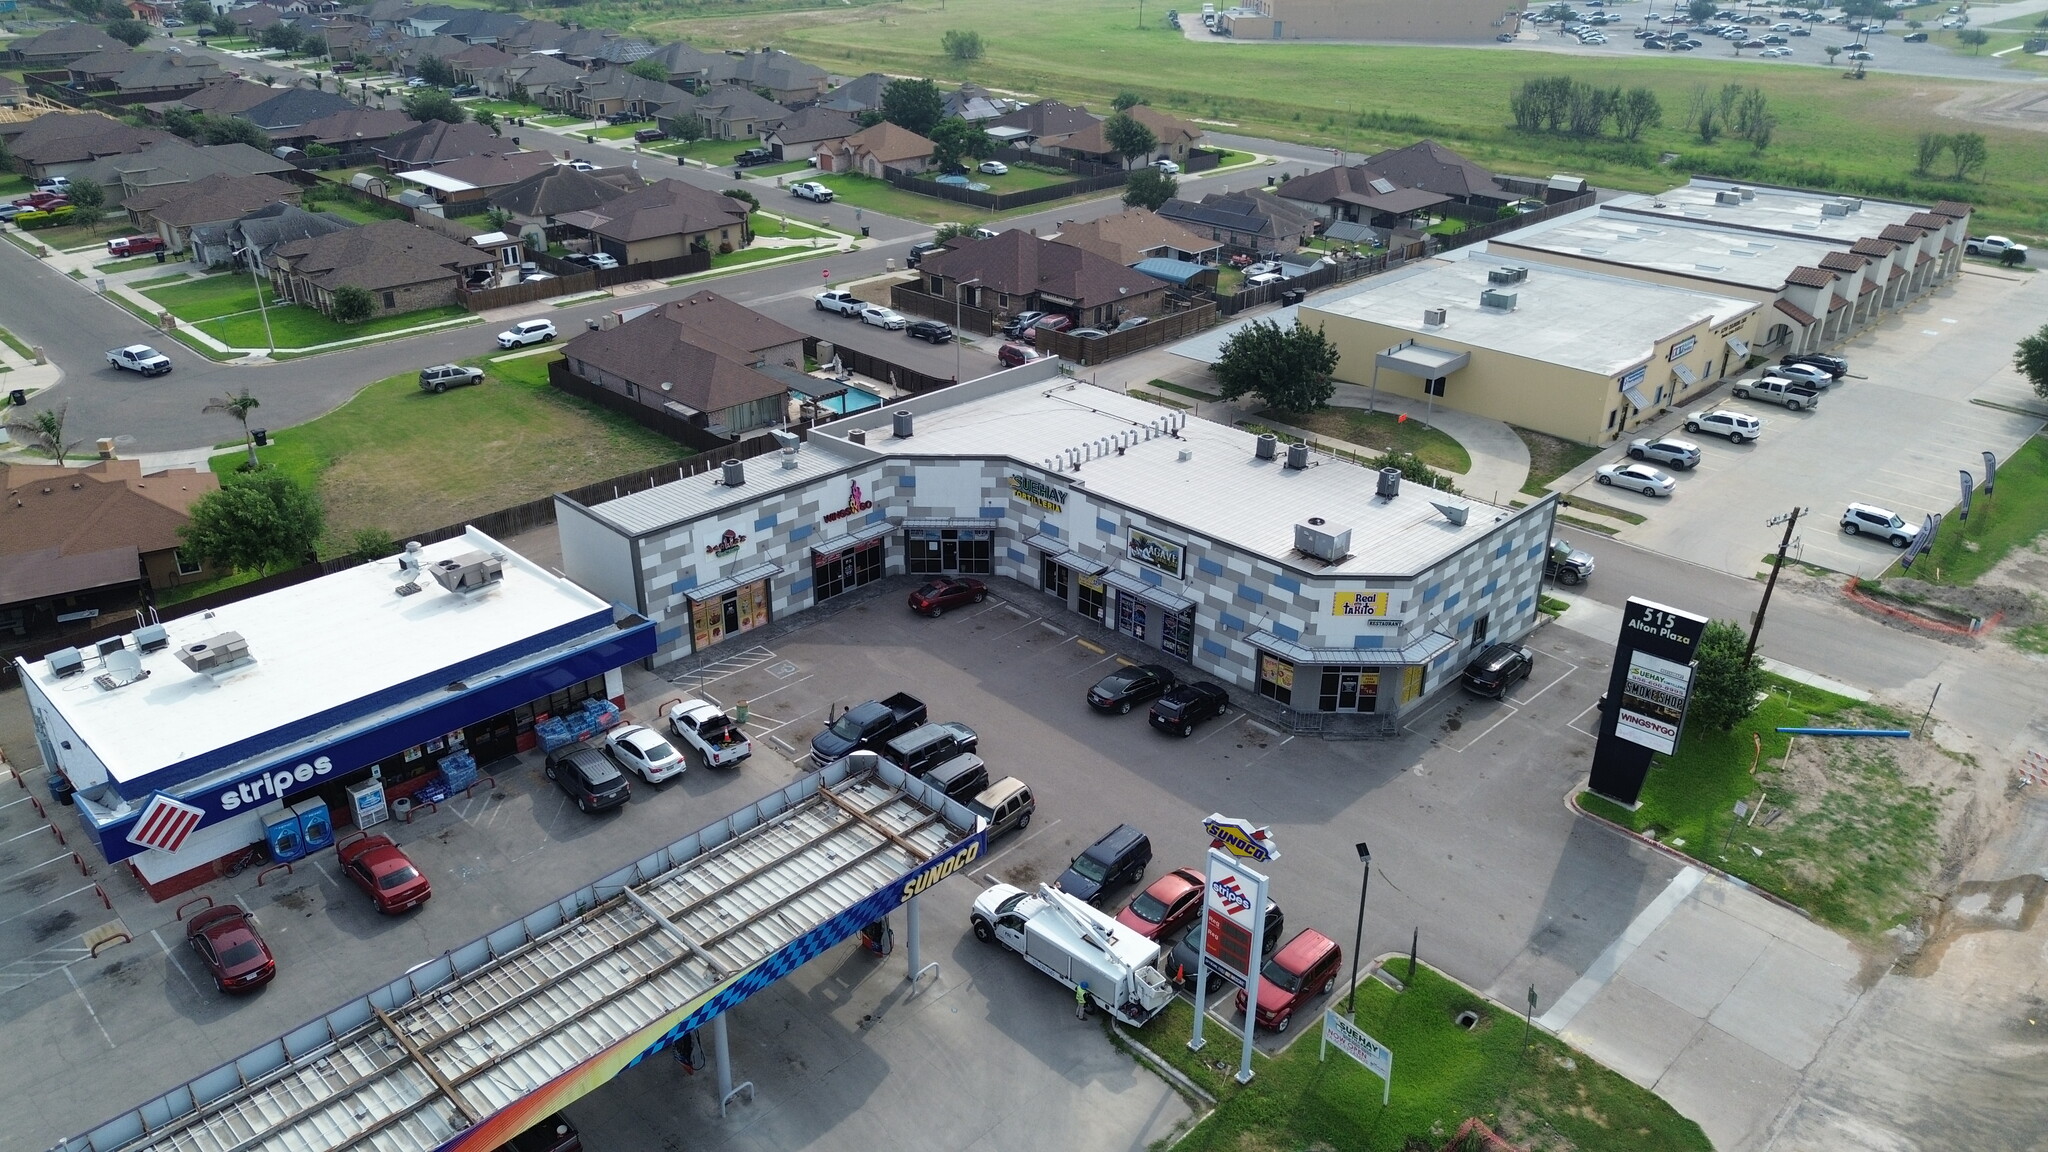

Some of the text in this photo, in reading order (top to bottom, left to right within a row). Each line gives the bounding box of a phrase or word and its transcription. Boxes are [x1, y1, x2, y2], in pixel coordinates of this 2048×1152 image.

[1012, 475, 1068, 504] SUEHAY
[1014, 491, 1062, 512] TORTILLERIA
[1355, 594, 1376, 603] Real
[1628, 619, 1690, 644] Alton Plaza
[1643, 608, 1676, 628] 515
[1626, 682, 1684, 709] SMOKE SHOP
[1621, 713, 1675, 737] WINGS'N'GO
[221, 756, 333, 811] stripes
[1208, 825, 1265, 860] SUNOCO
[901, 841, 979, 903] SUNOCO
[1212, 883, 1251, 910] stripes
[1328, 1028, 1346, 1044] NOW
[1348, 1042, 1367, 1059] OPEN
[1339, 1021, 1378, 1052] SUEHAY
